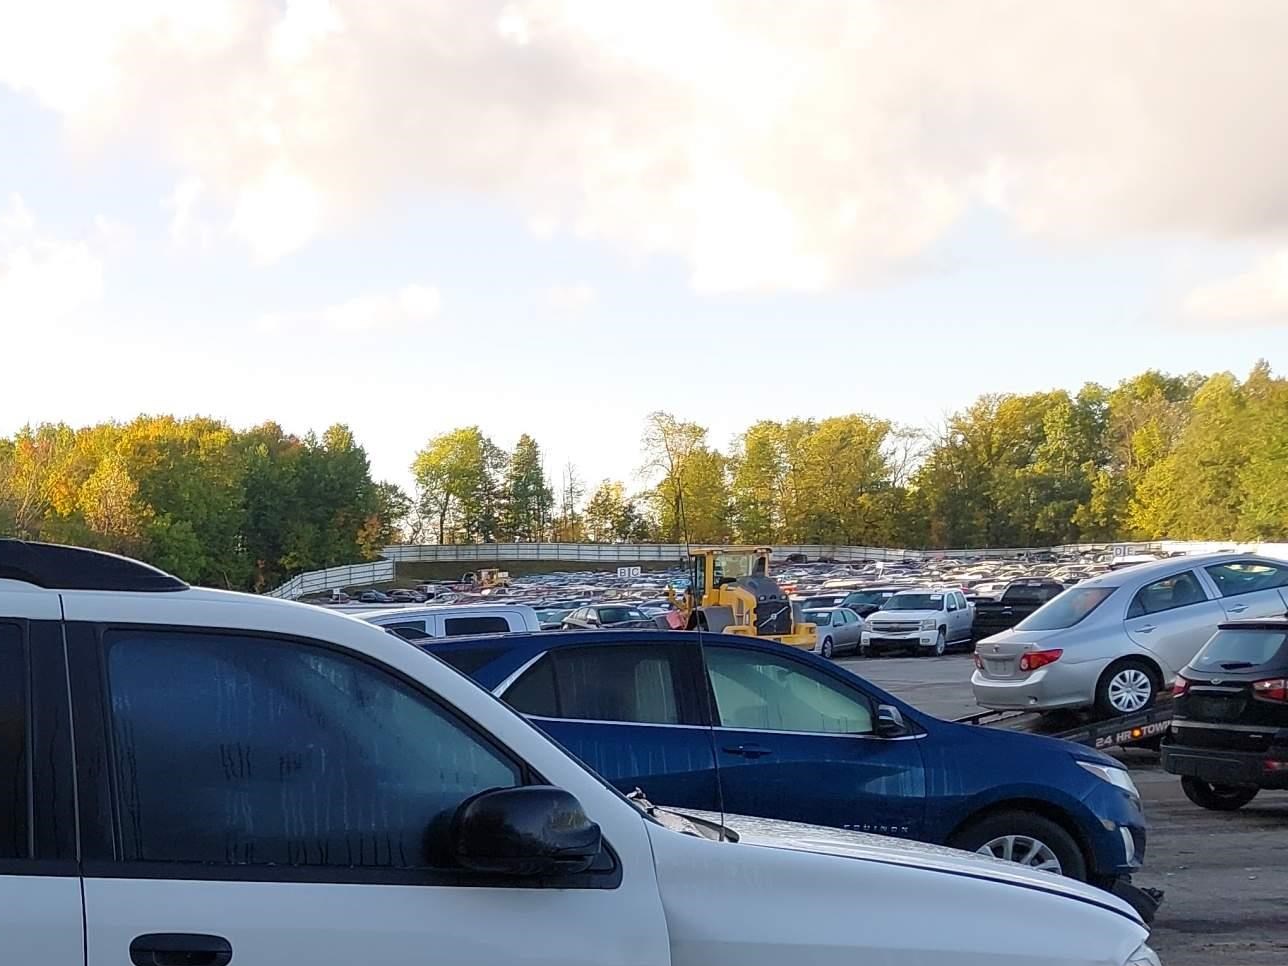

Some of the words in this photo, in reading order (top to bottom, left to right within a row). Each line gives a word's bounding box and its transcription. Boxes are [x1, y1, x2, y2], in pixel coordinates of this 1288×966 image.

[619, 568, 626, 577] B
[631, 567, 639, 576] C
[1095, 735, 1112, 748] 24
[1116, 730, 1132, 743] HR
